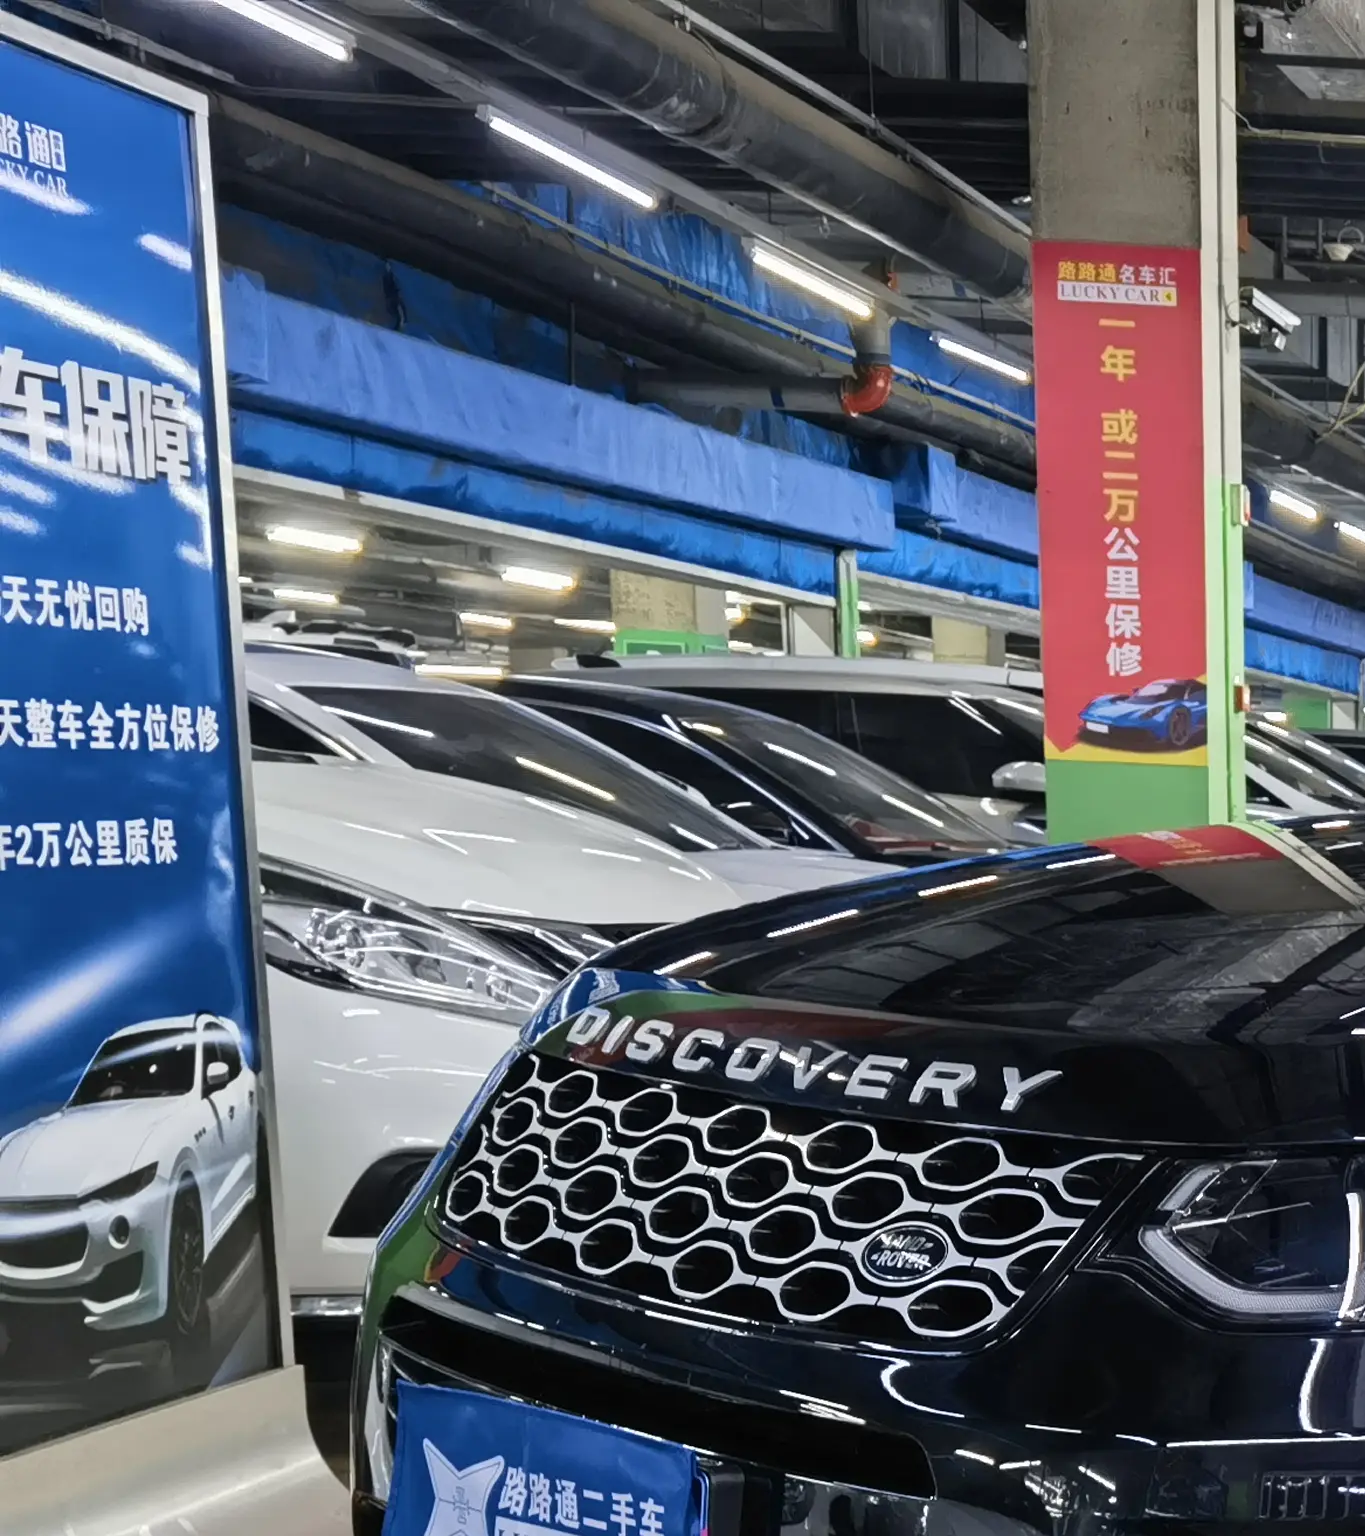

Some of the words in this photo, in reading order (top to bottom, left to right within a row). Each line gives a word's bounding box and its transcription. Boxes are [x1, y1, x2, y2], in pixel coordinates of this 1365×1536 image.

[34, 170, 69, 198] CAR
[1057, 260, 1176, 286] 路路通名车汇
[1060, 283, 1119, 300] LUCKY
[1124, 286, 1160, 302] CAR
[1, 575, 149, 636] 天无忧回购
[0, 698, 220, 752] 天整车全方位保修
[566, 1006, 1063, 1112] DISCOVERY
